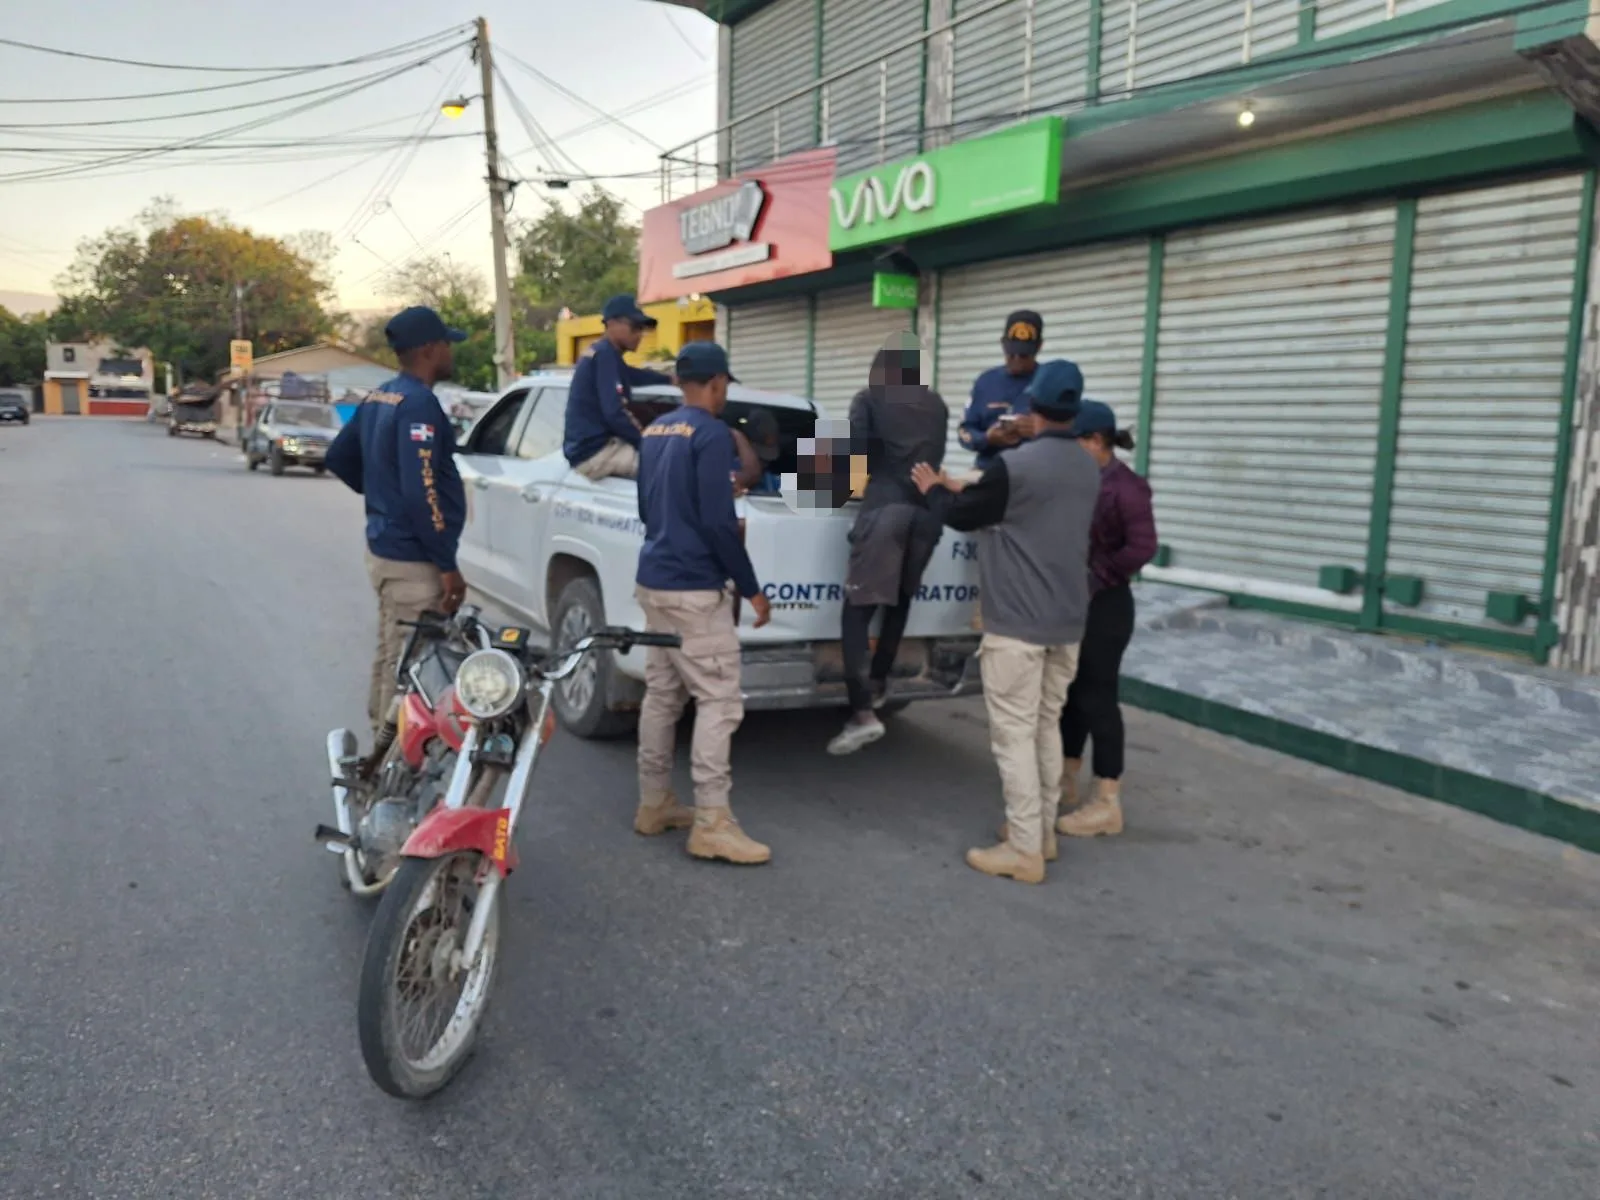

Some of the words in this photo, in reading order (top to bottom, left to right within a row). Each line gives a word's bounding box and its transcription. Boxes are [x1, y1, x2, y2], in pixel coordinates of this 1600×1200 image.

[828, 161, 935, 229] viva
[763, 583, 846, 601] CONTR
[914, 584, 980, 601] RATOR
